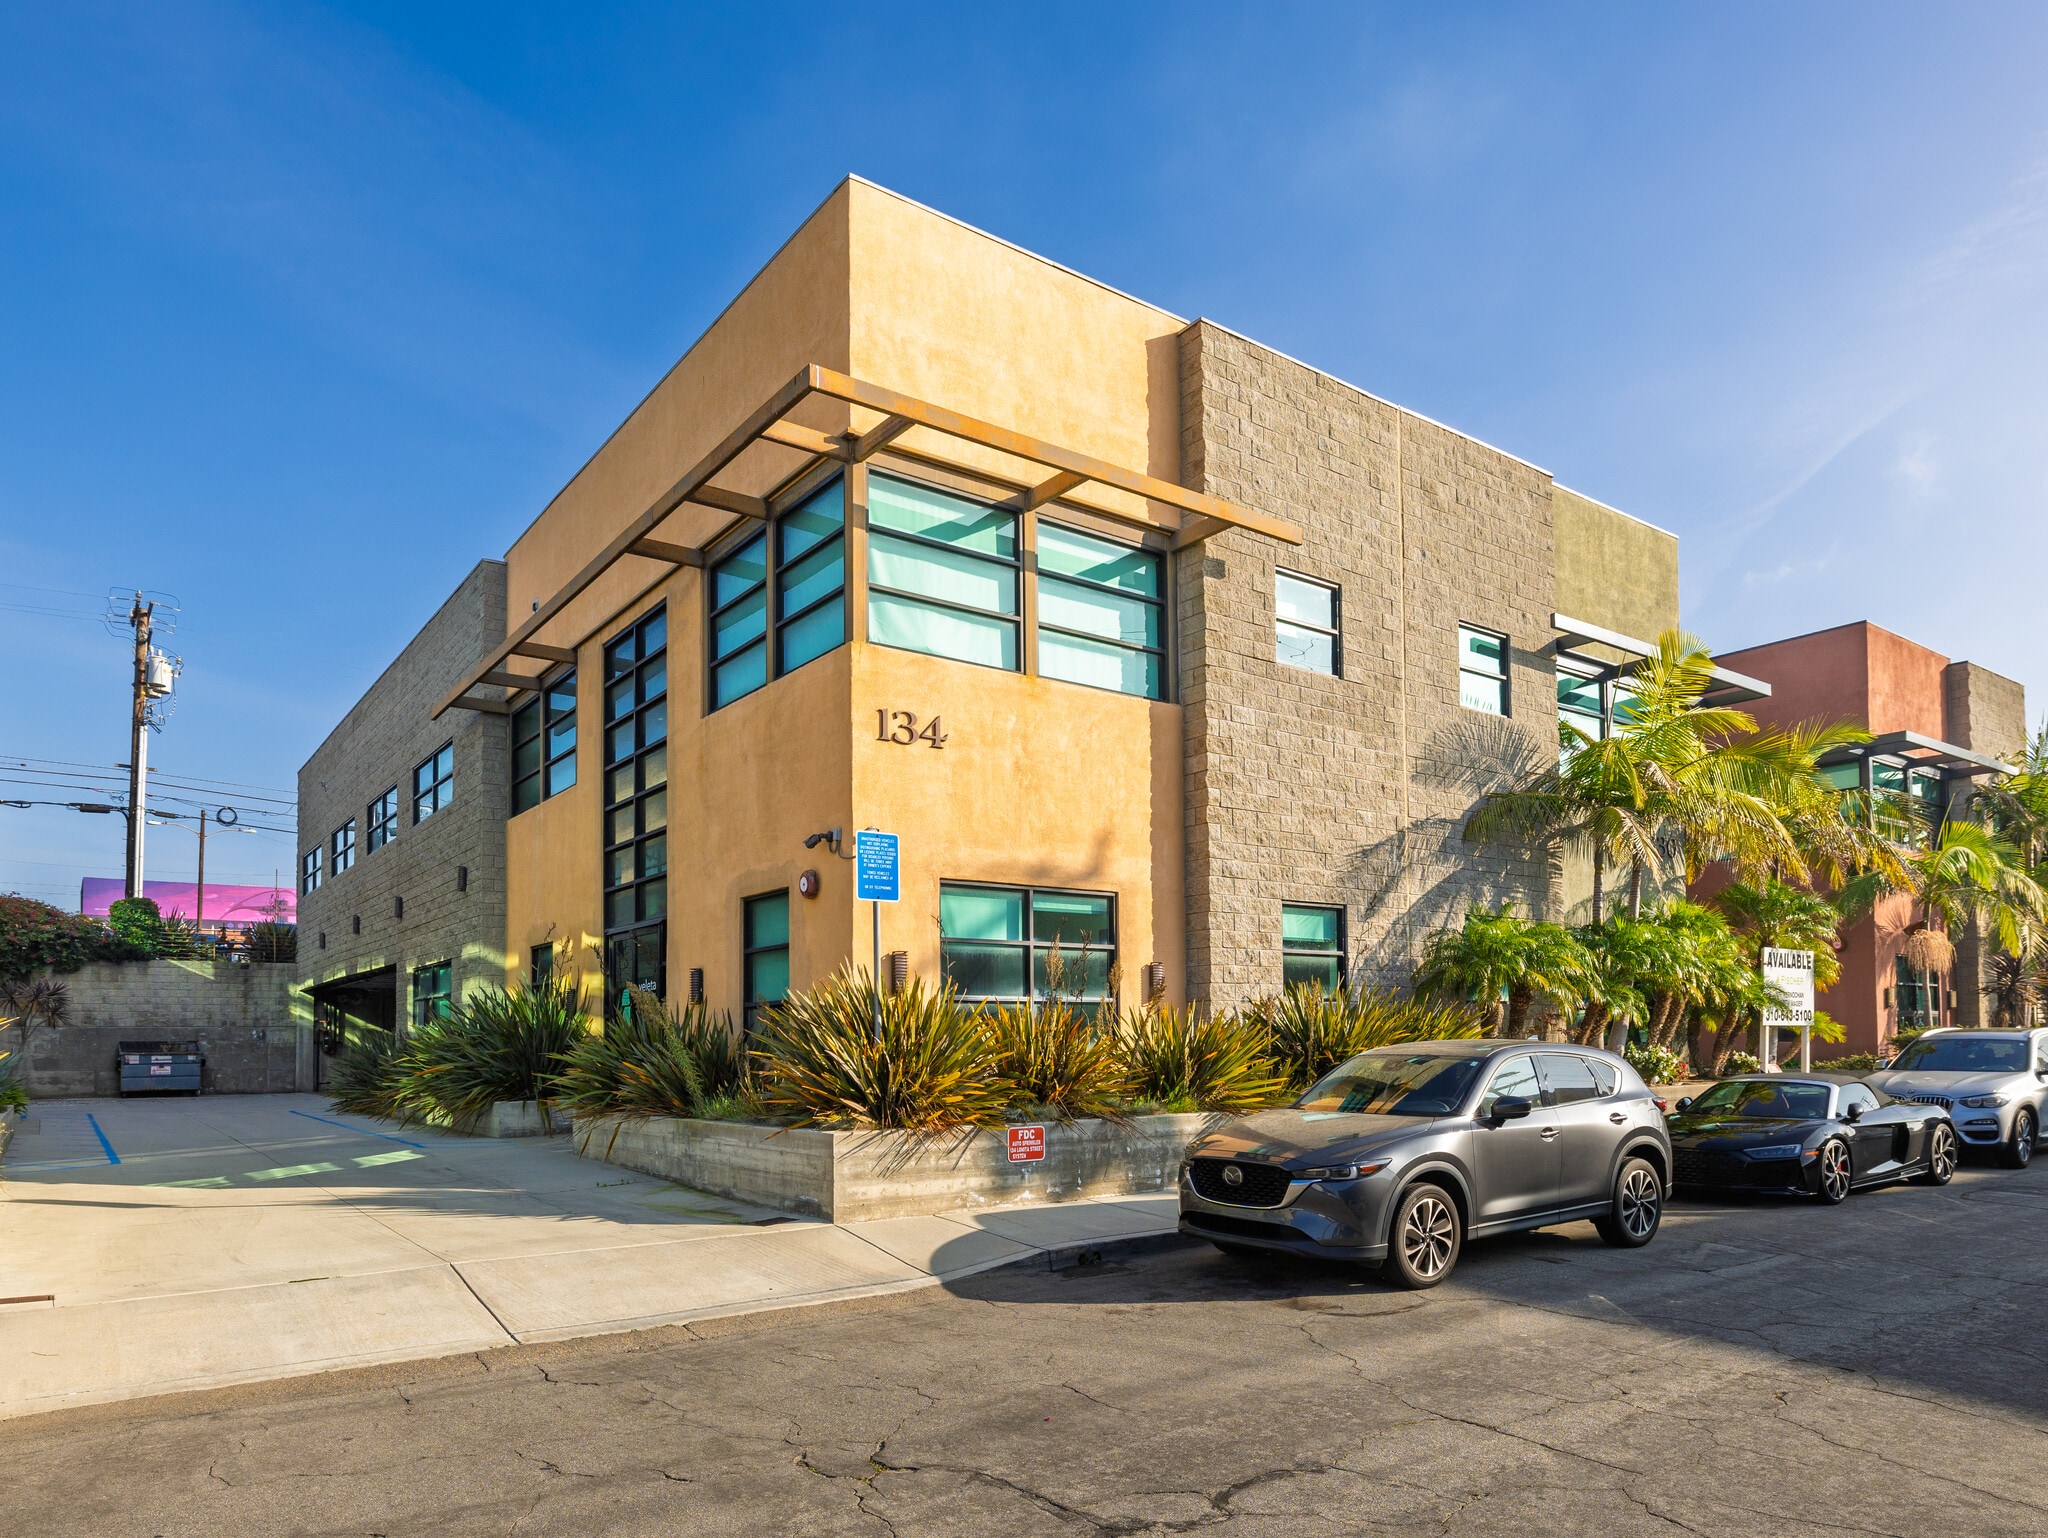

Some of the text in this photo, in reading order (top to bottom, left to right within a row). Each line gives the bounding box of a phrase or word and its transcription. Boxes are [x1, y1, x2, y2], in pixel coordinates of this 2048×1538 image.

[875, 708, 949, 750] 134
[1767, 952, 1811, 970] AVAILABLE
[638, 979, 657, 991] veleta
[1018, 1129, 1035, 1140] FDC
